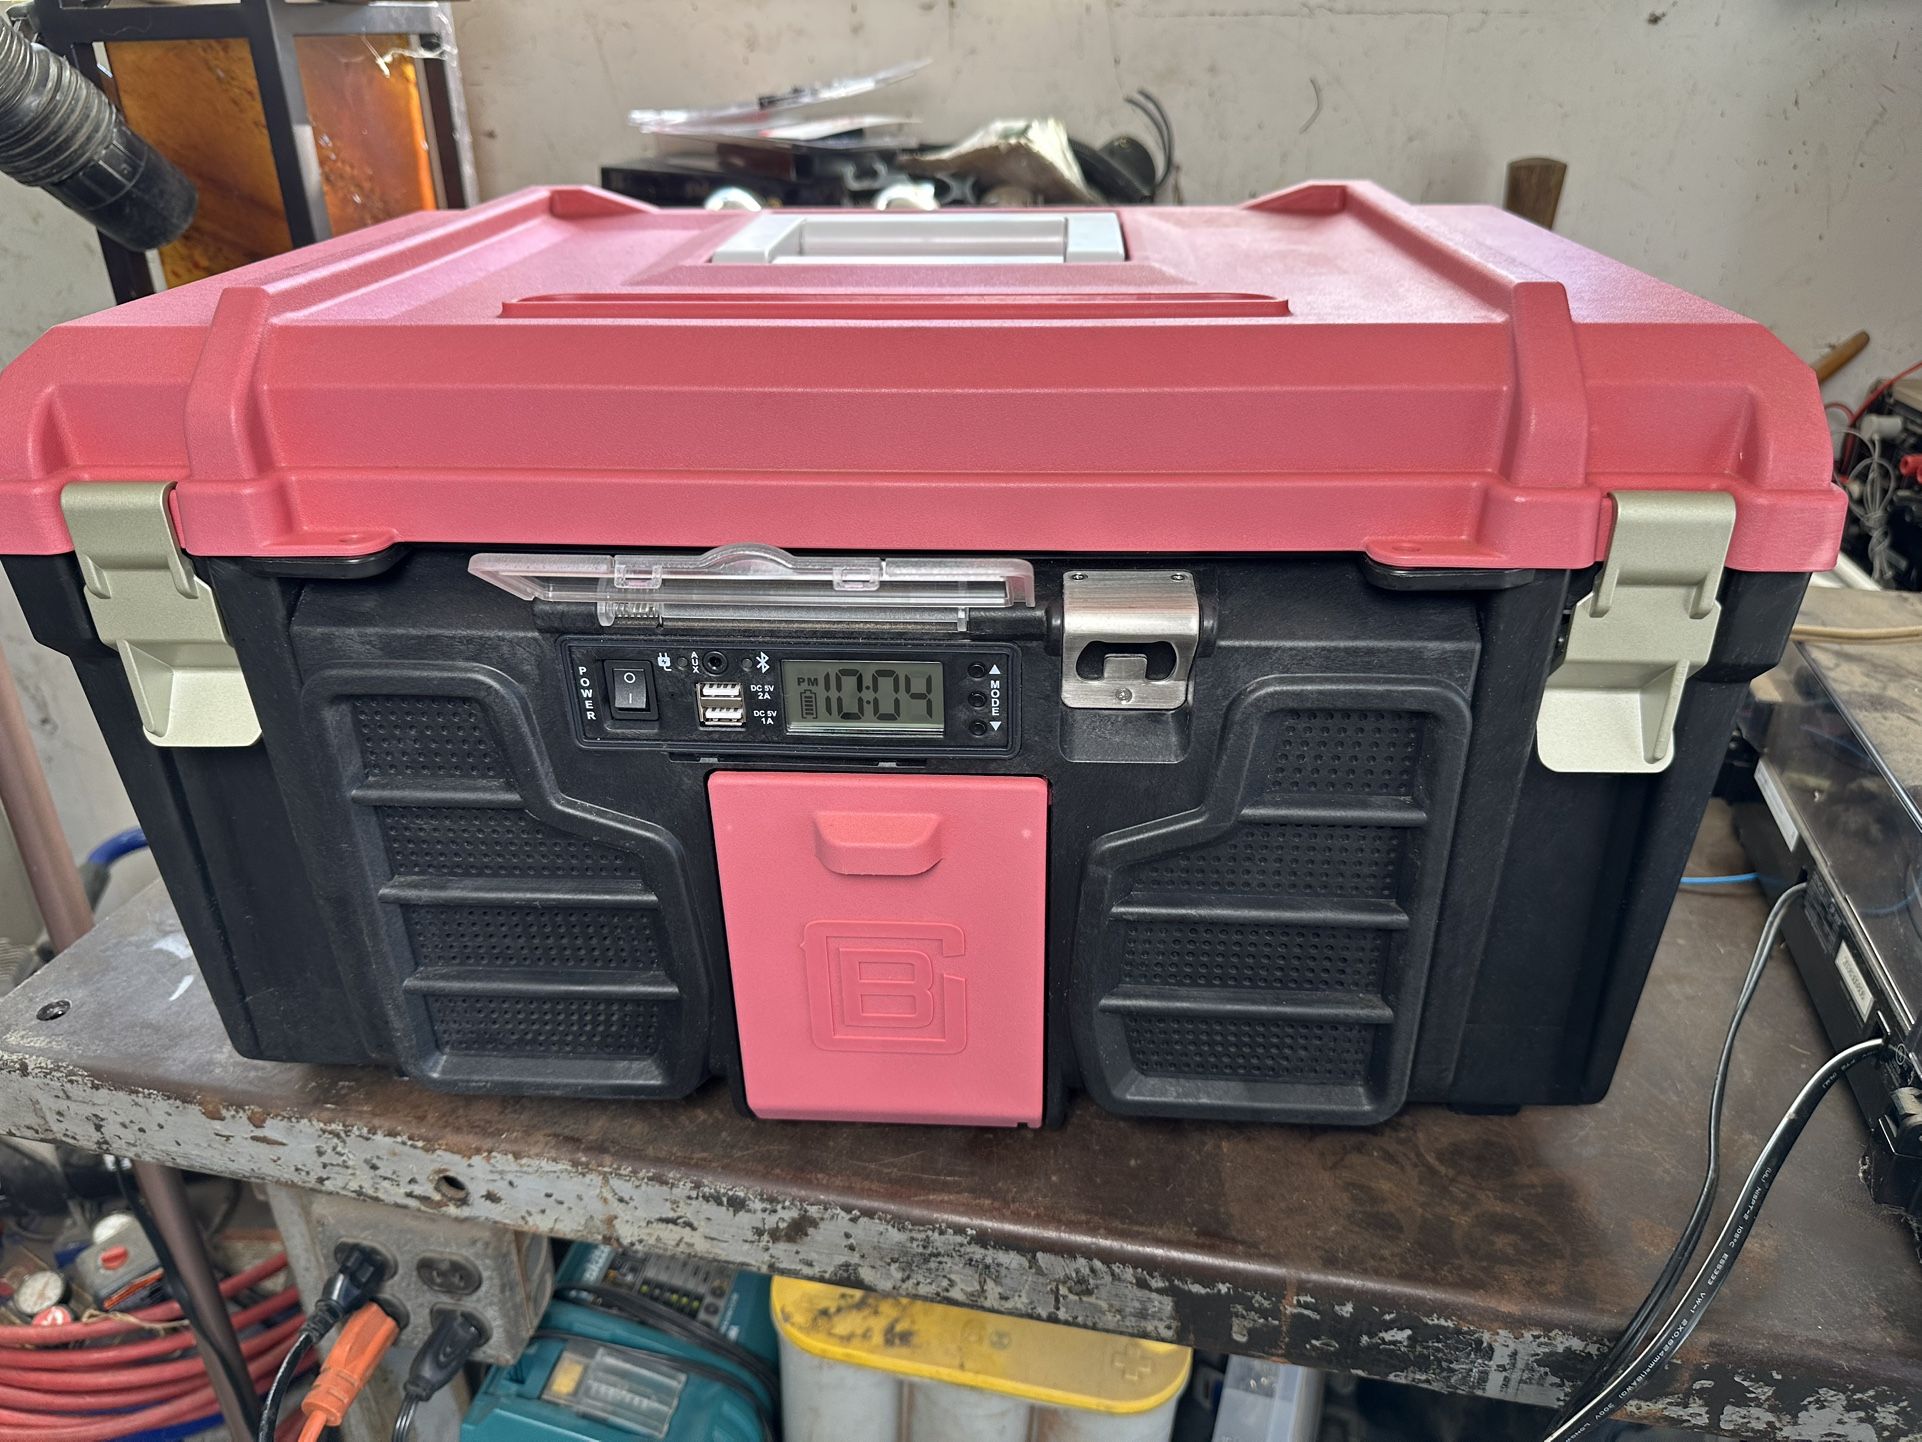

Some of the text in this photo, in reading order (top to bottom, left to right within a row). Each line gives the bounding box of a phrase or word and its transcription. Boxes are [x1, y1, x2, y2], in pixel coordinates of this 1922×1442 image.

[691, 651, 700, 674] AUX
[578, 666, 597, 720] POWER
[758, 692, 771, 700] 2A
[797, 668, 933, 721] PM 10:04
[990, 680, 1000, 716] MODE
[1761, 1167, 1772, 1183] (UL)
[1690, 1292, 1706, 1314] VW-1
[1594, 1402, 1616, 1420] 300V
